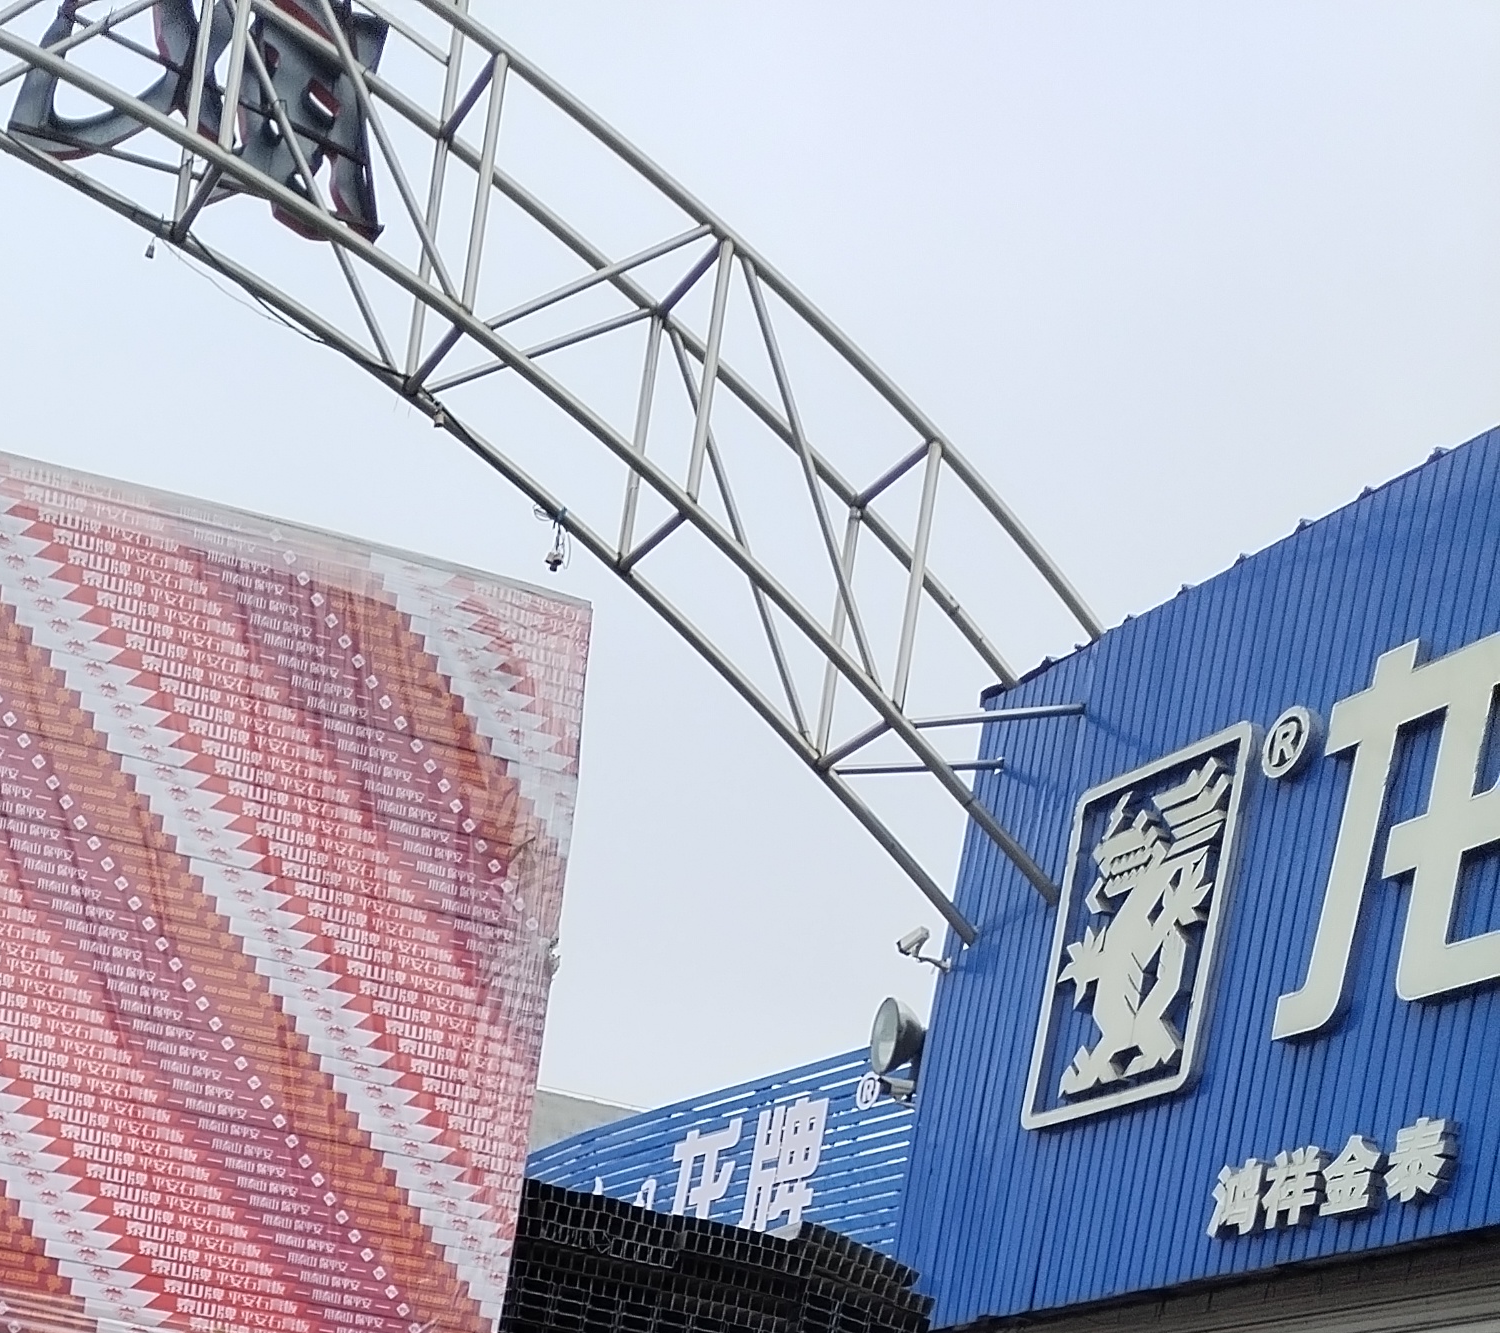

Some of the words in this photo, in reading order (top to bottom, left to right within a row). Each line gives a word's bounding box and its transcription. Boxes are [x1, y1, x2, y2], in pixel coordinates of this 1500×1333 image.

[19, 1064, 82, 1089] 泰山牌
[73, 1143, 134, 1167] 泰山牌
[1207, 1116, 1457, 1240] 鸿祥金泰
[114, 1202, 173, 1225] 泰山牌
[151, 1259, 212, 1283] 泰山牌
